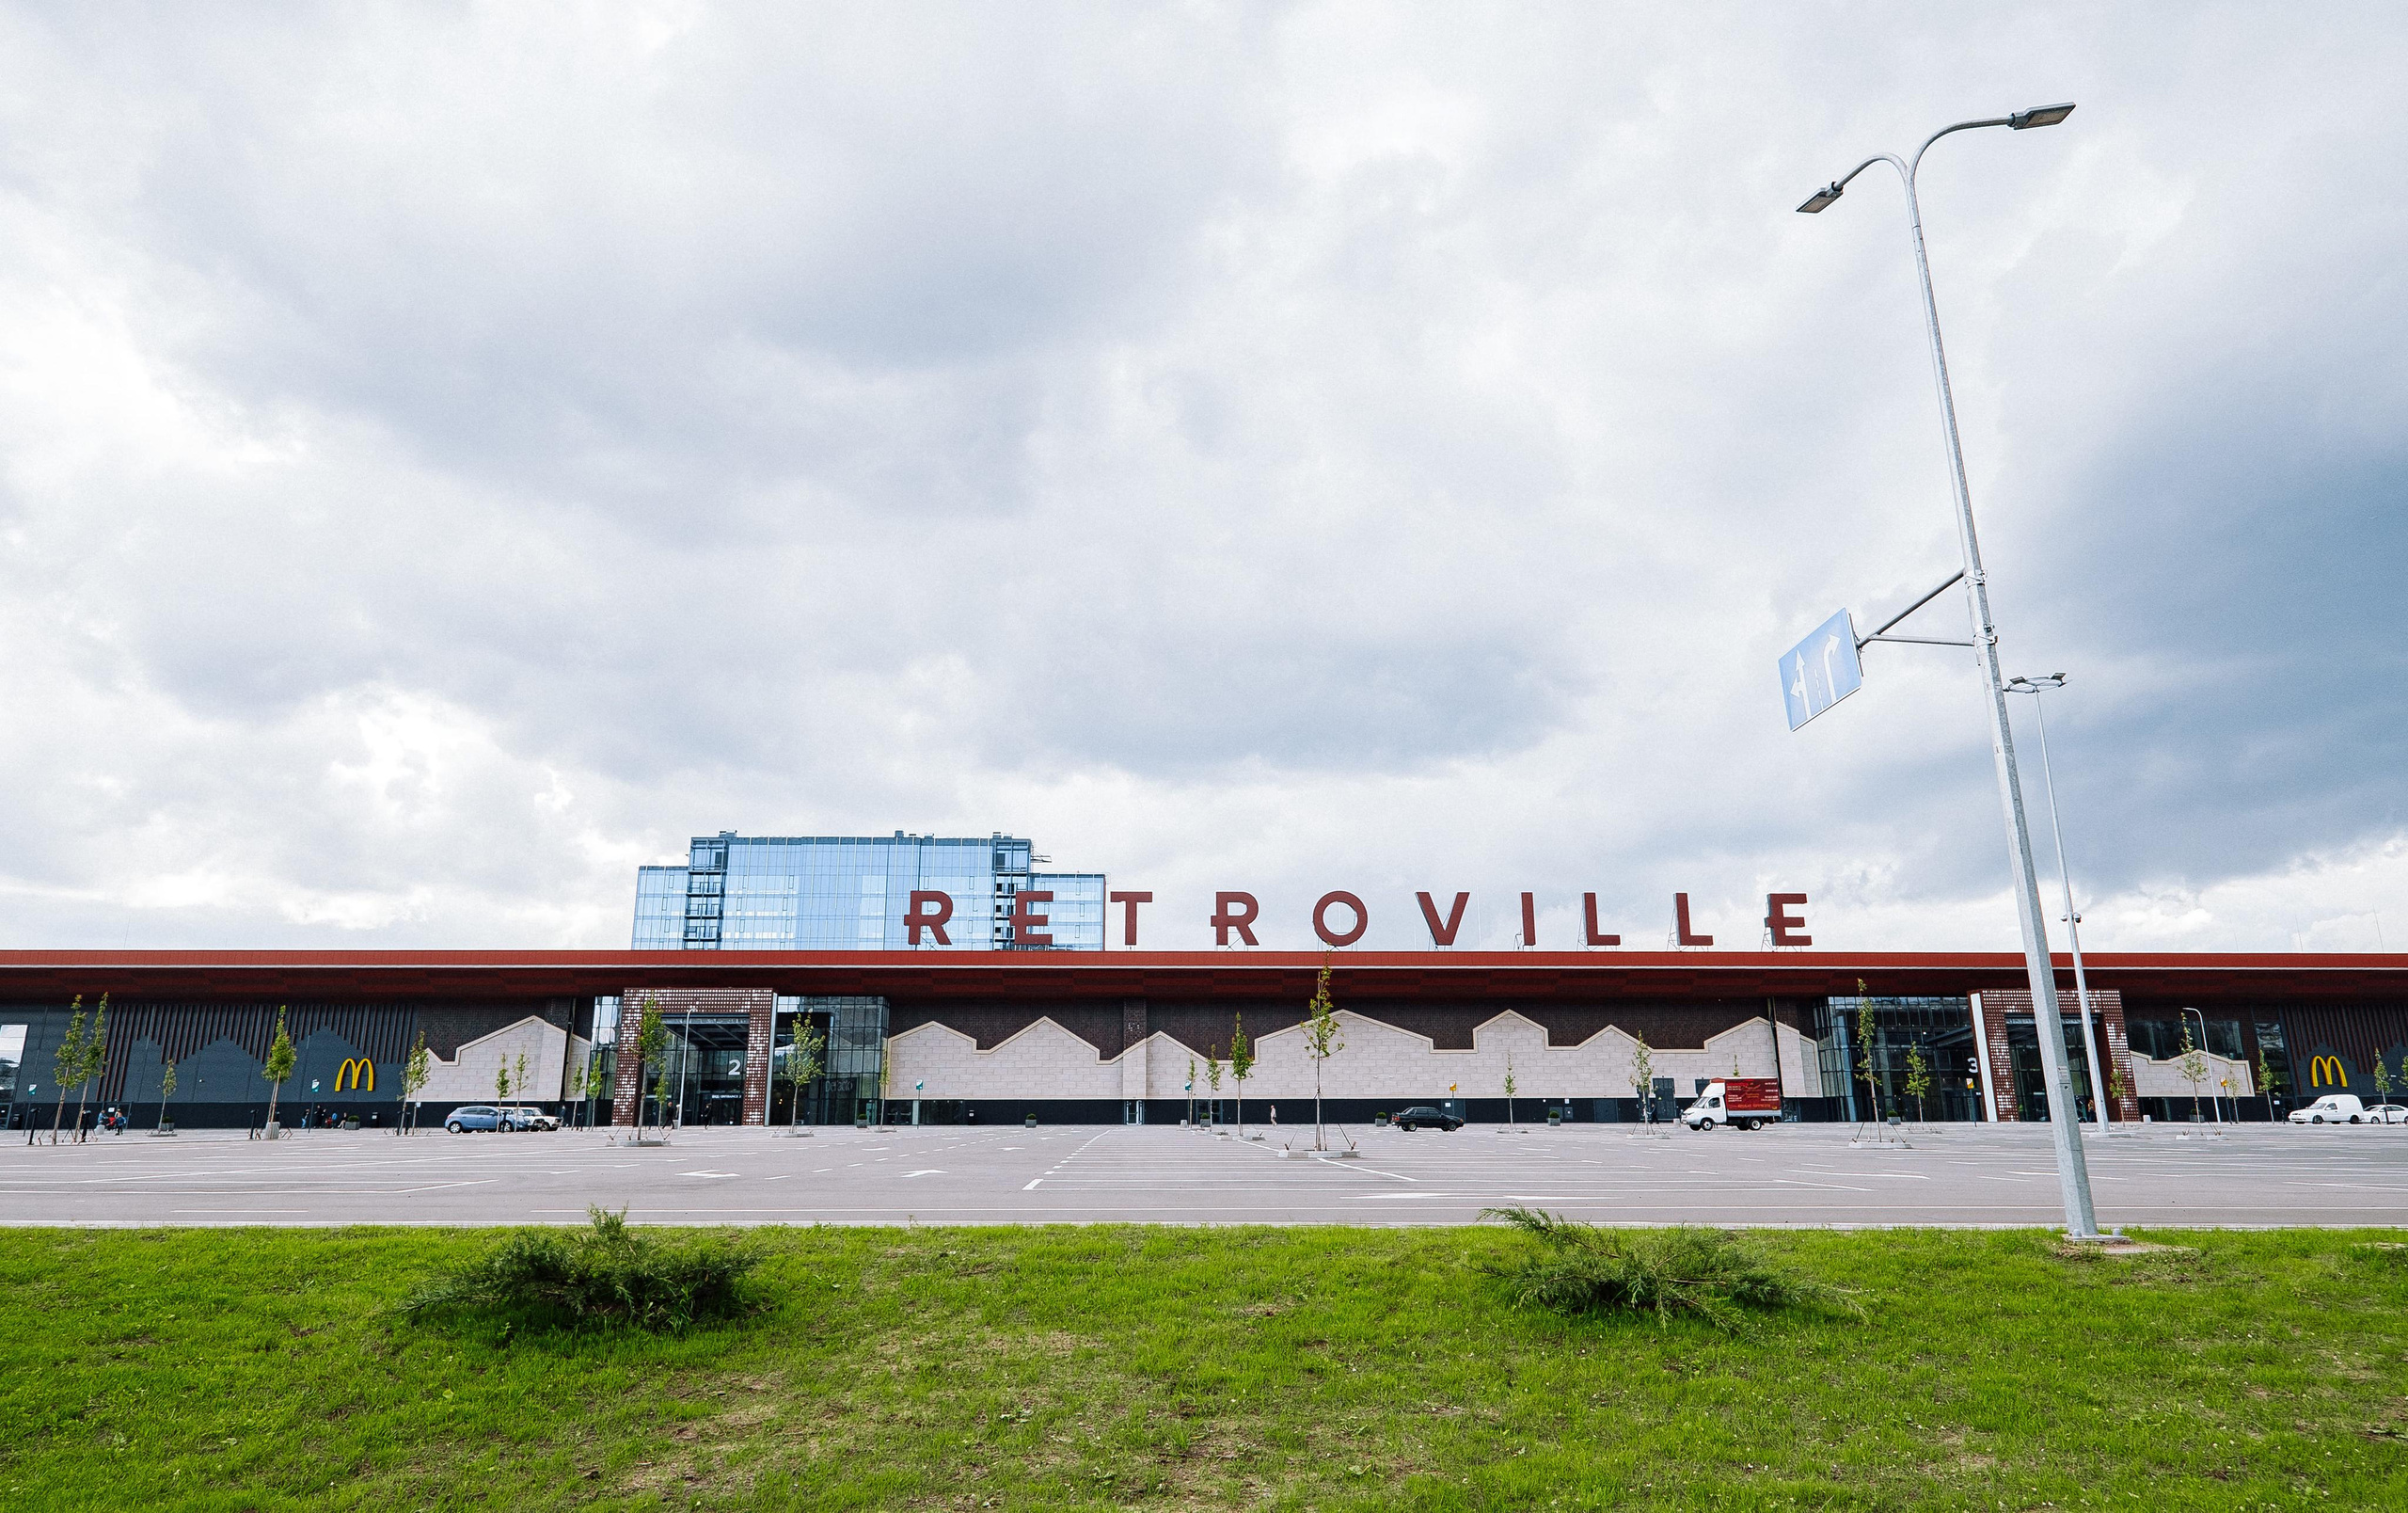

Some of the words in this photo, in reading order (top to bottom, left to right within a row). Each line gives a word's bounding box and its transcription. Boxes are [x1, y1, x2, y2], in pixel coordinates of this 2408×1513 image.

[904, 890, 1813, 947] RETROVILLE
[728, 1059, 741, 1075] 2
[1967, 1057, 1979, 1073] 3
